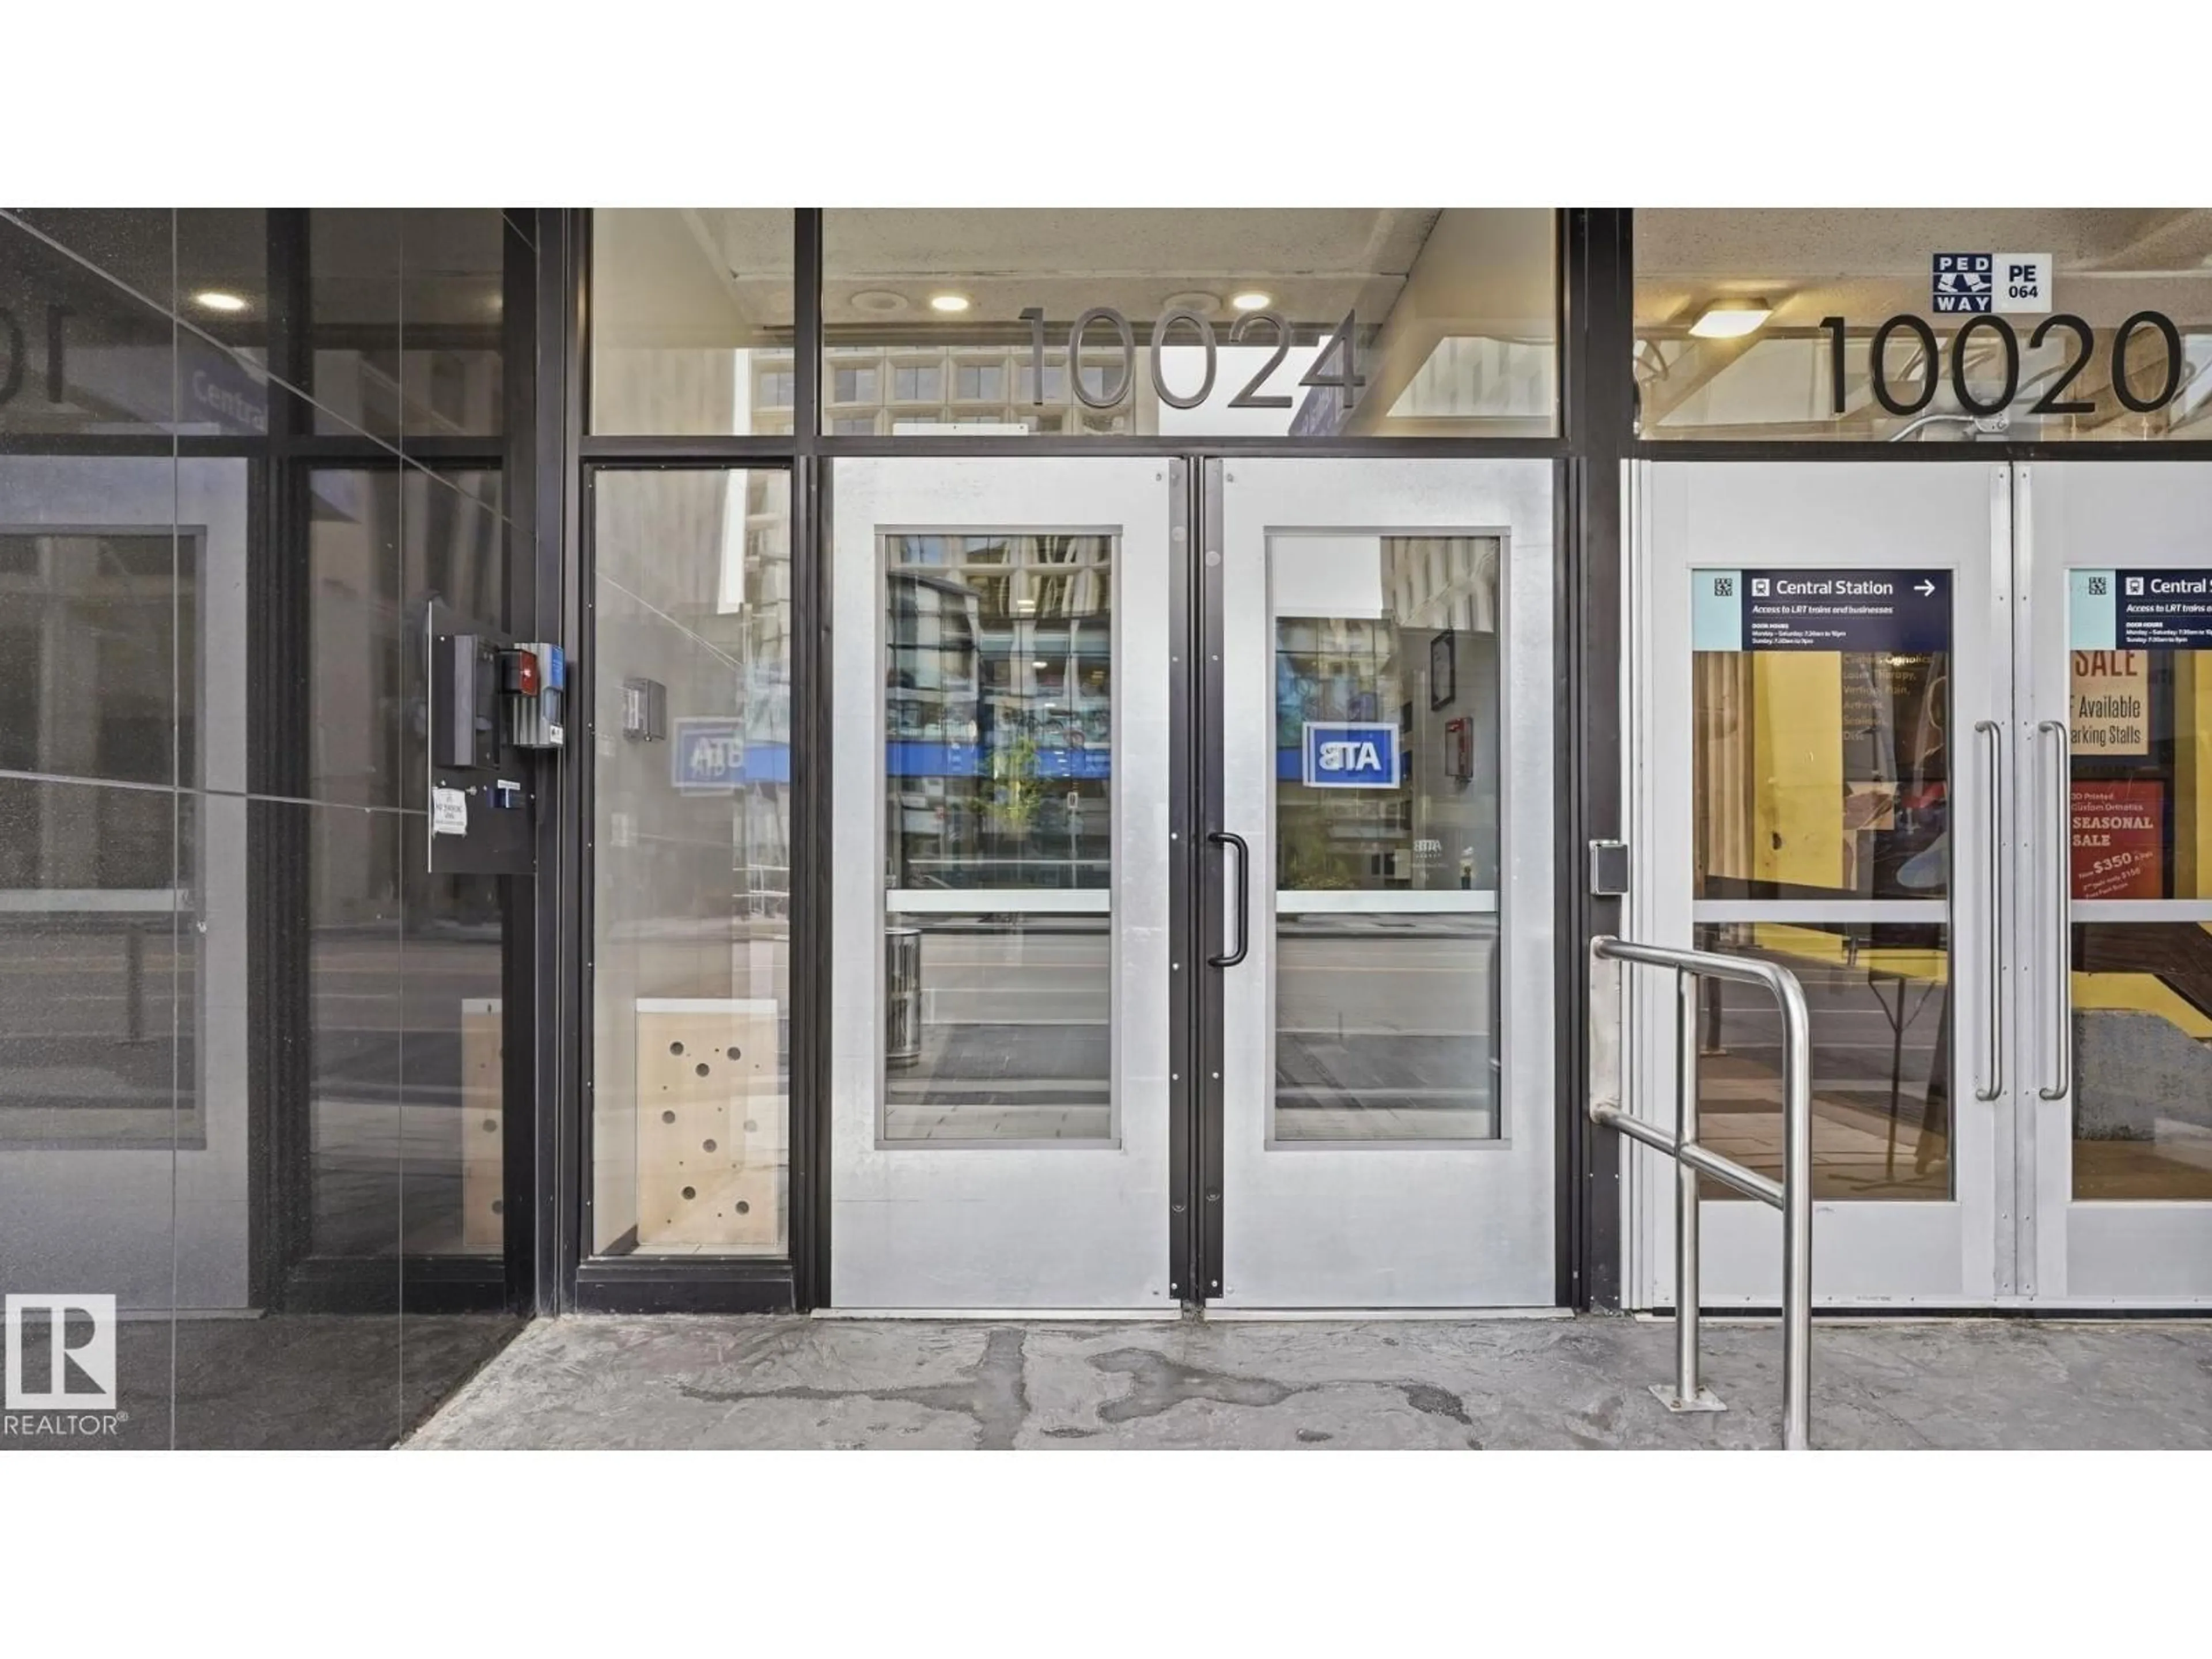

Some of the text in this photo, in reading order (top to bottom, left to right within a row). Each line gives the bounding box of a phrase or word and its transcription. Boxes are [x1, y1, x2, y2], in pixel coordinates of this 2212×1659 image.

[1939, 257, 1989, 271] PED
[2009, 265, 2037, 282] PE
[2008, 286, 2038, 298] 064
[1937, 296, 1990, 311] WAY
[1018, 306, 1366, 410] 10024
[1820, 310, 2182, 416] 10020
[193, 369, 268, 434] Centra
[1776, 579, 1893, 594] Central Station
[2150, 578, 2206, 593] Central
[1752, 605, 1781, 613] Access
[1782, 605, 1790, 613] to
[1808, 605, 1831, 613] trains
[1848, 605, 1893, 613] businesses
[2126, 604, 2154, 612] Access
[2156, 604, 2164, 612] to
[2165, 604, 2181, 613] LRT
[2183, 604, 2205, 612] trains
[2079, 694, 2141, 718] Available
[2071, 725, 2141, 748] arking Stalls
[2084, 793, 2113, 801] Printed
[2072, 816, 2154, 830] SEASONAL
[2072, 834, 2111, 847] SALE
[2093, 852, 2132, 874] $350
